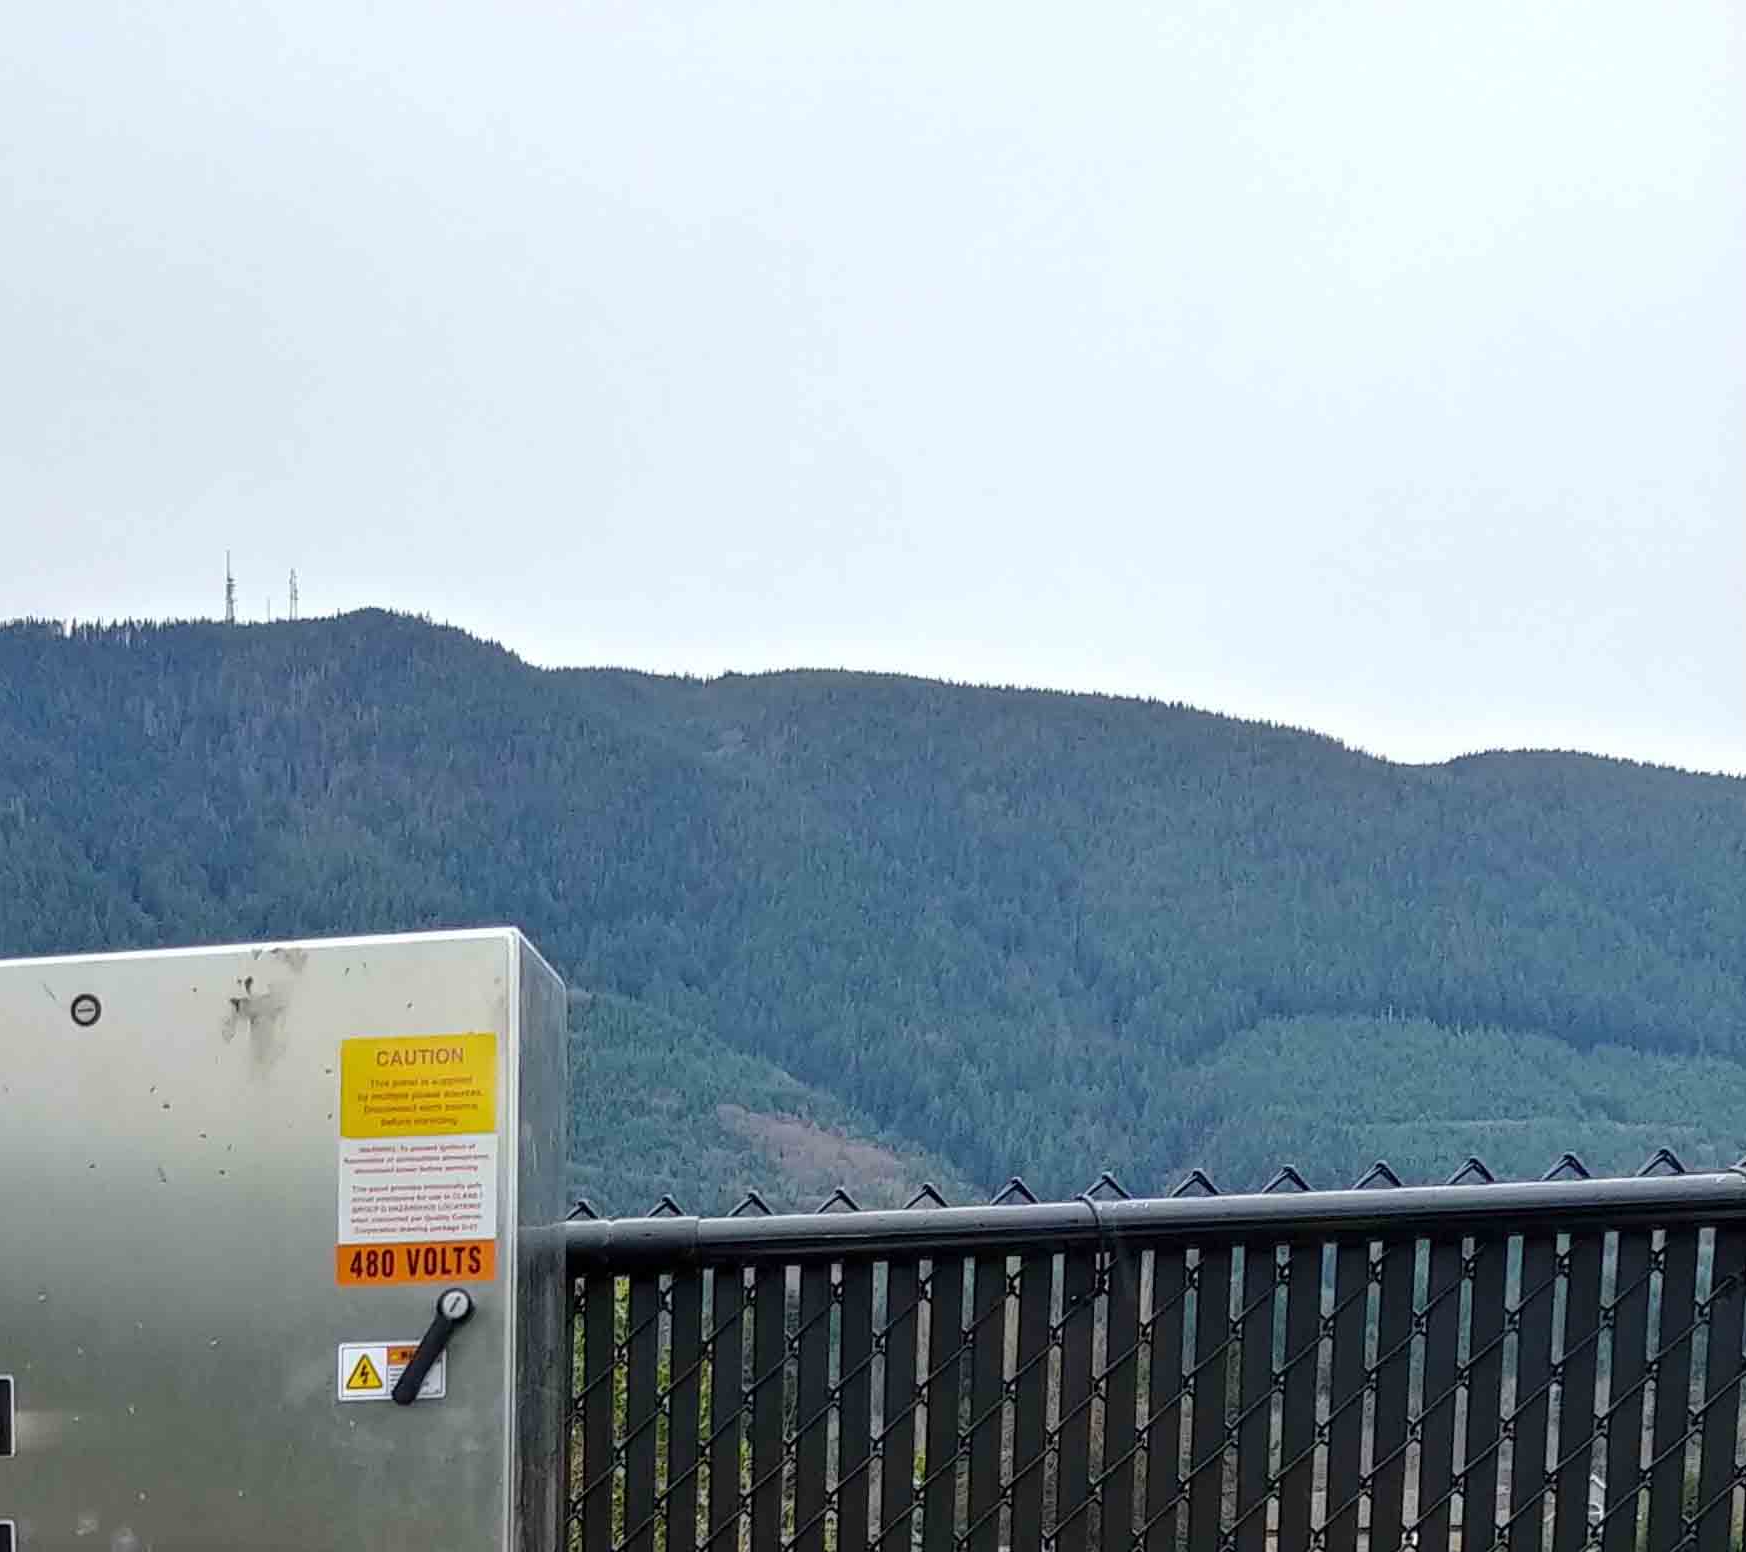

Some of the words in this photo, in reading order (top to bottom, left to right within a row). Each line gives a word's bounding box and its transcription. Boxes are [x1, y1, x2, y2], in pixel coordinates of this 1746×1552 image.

[376, 1048, 463, 1066] CAUTION
[350, 1249, 395, 1278] 480
[406, 1246, 482, 1276] VOLTS
